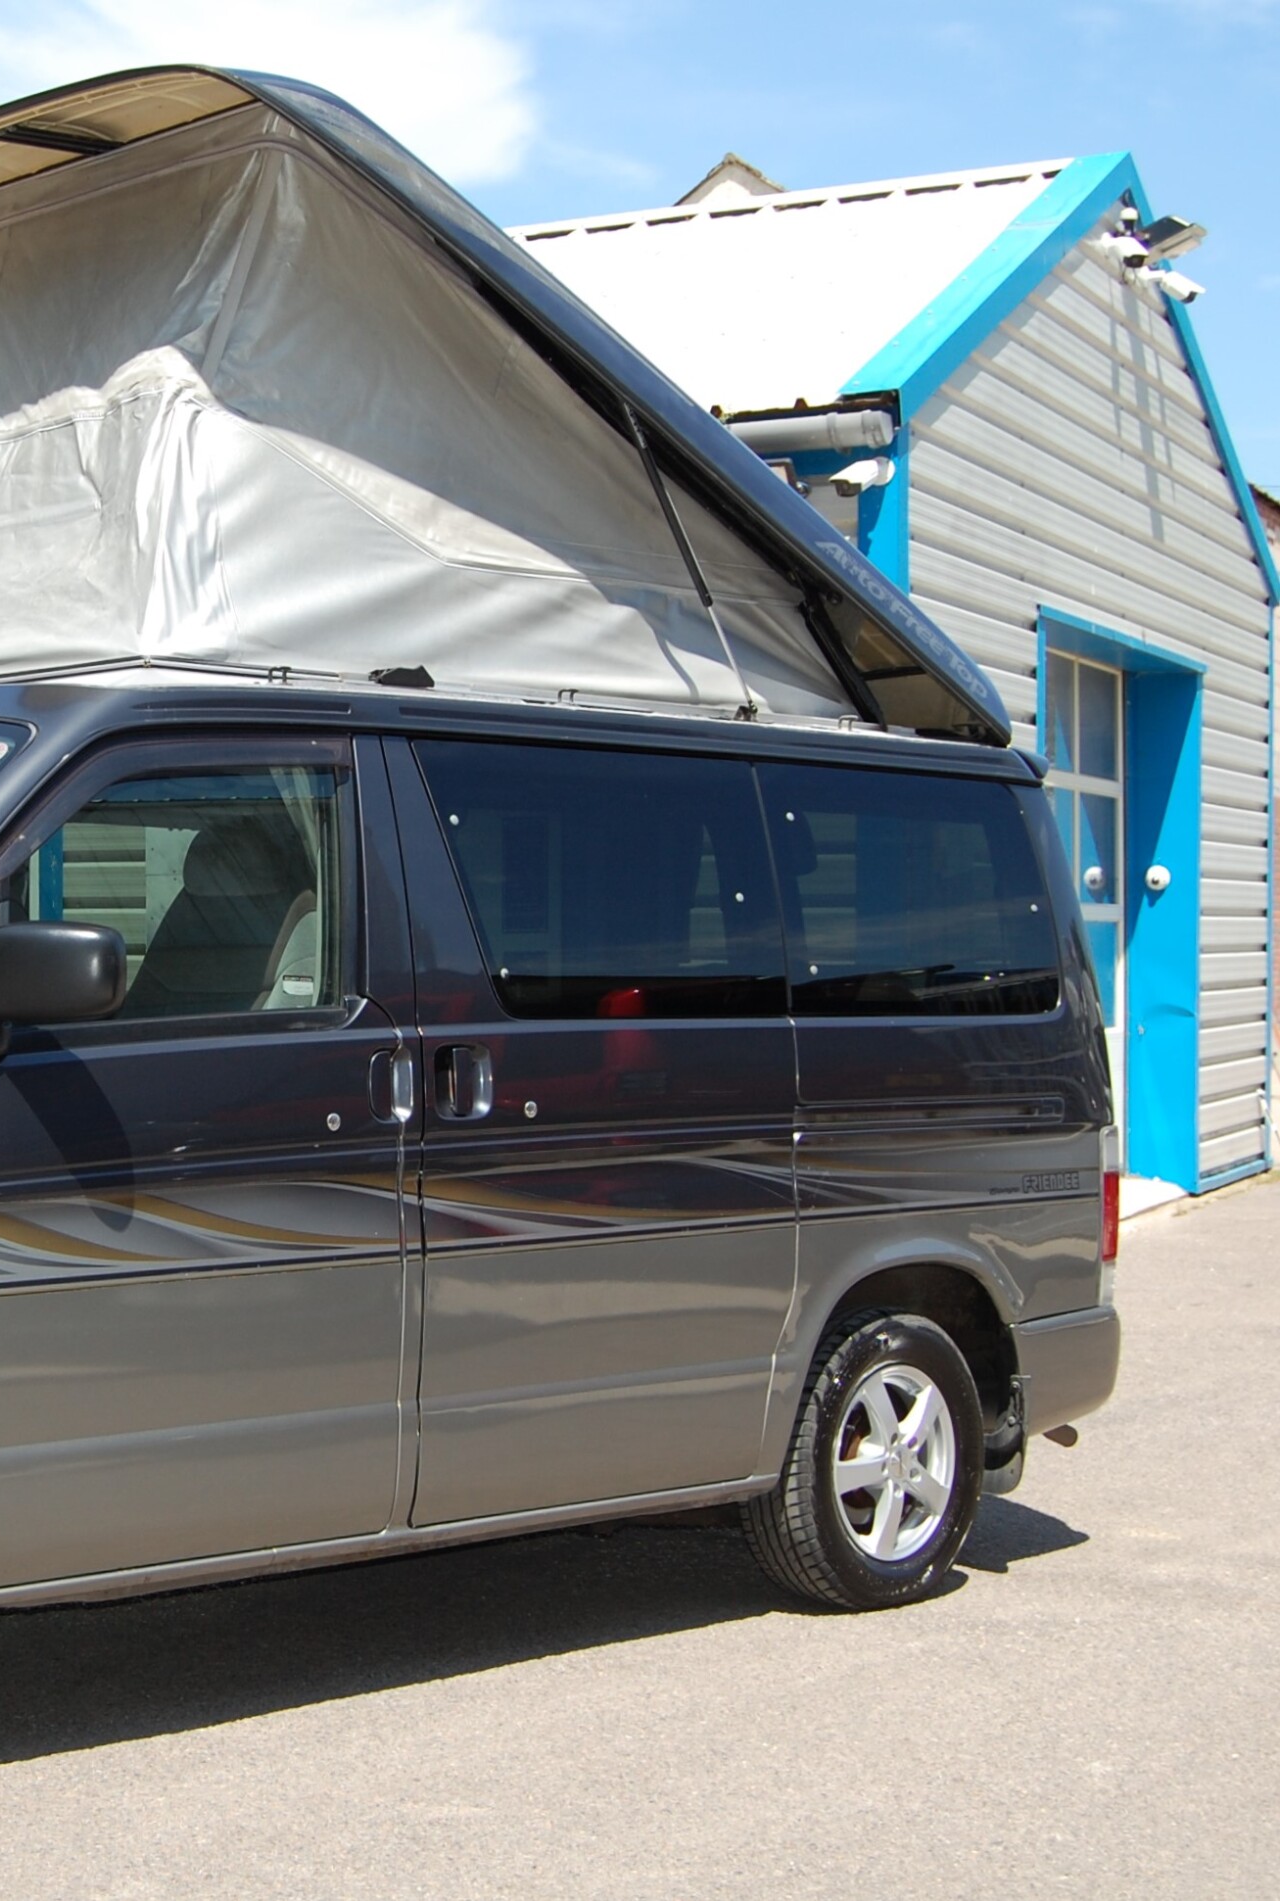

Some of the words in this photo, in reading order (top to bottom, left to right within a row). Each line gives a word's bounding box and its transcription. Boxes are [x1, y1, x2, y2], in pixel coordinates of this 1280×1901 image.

[814, 541, 887, 601] Auto
[888, 597, 943, 656] Free
[945, 645, 988, 699] Top
